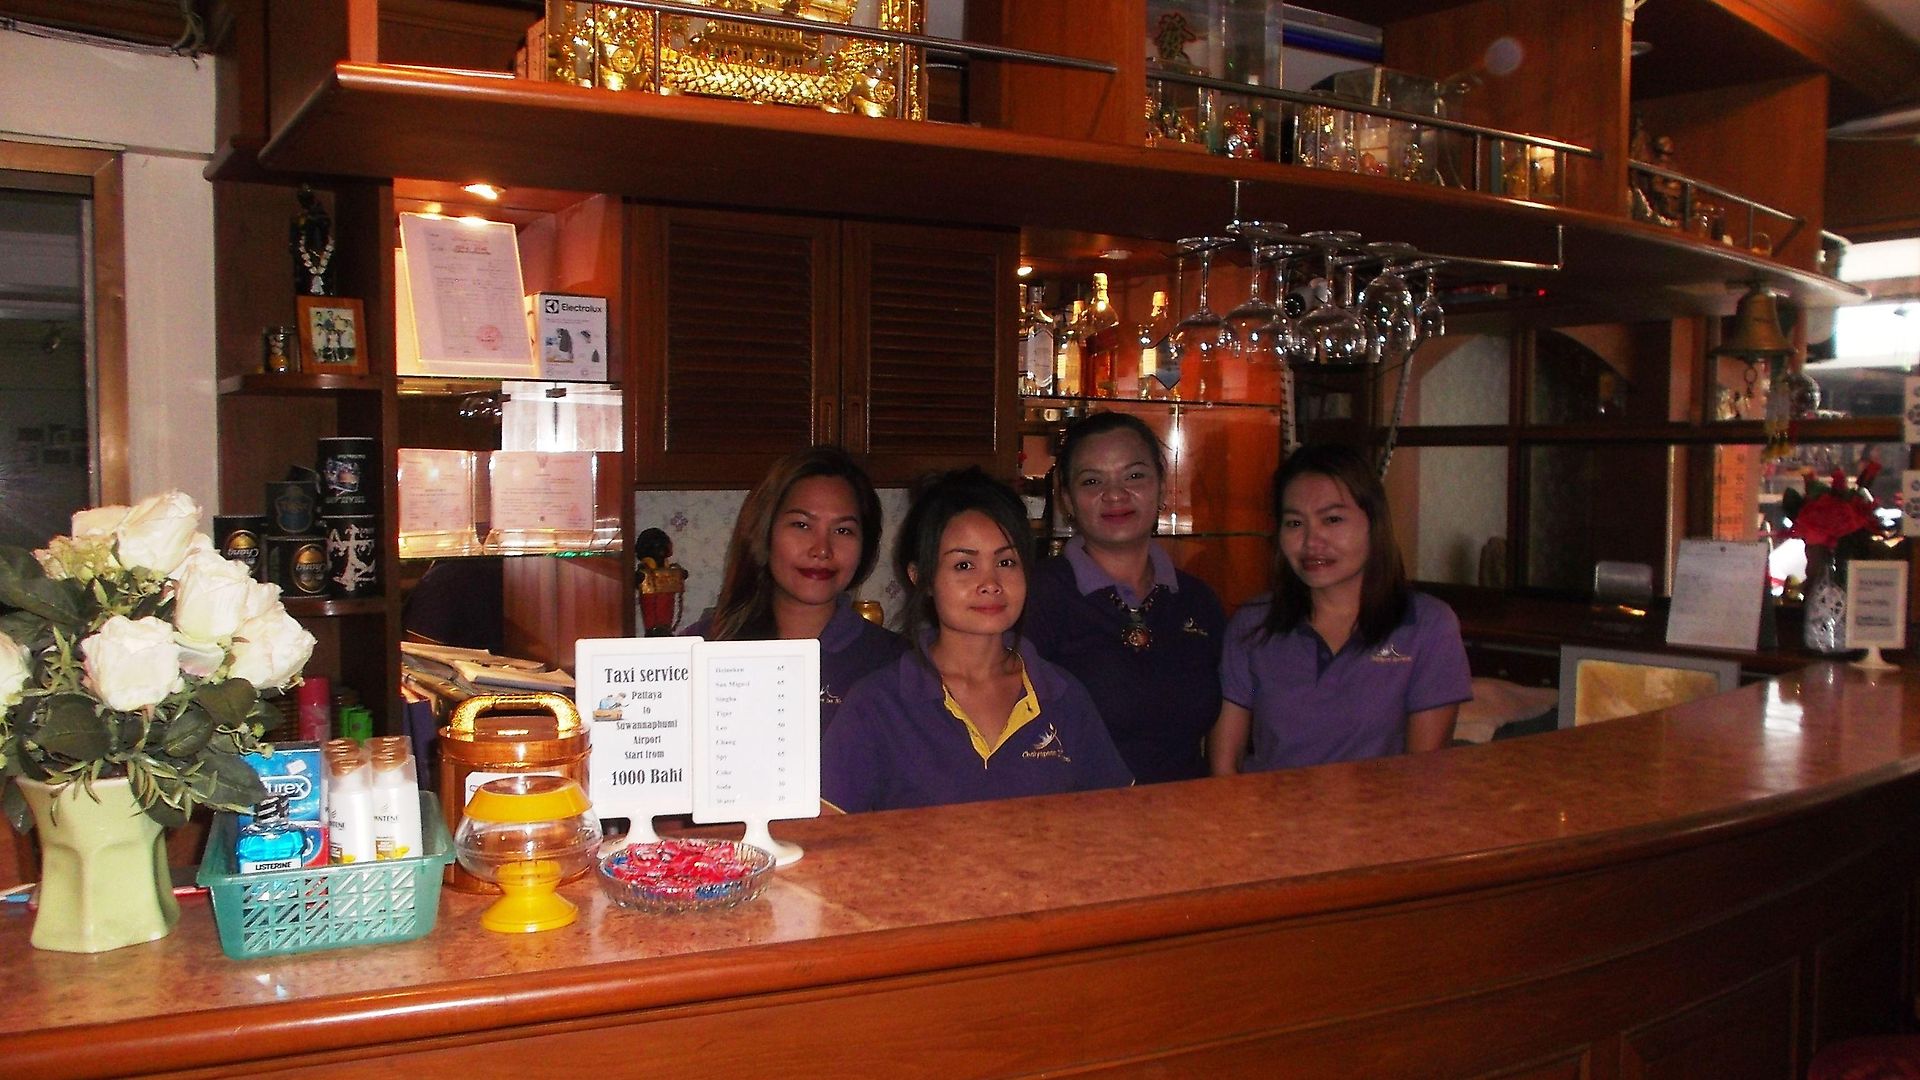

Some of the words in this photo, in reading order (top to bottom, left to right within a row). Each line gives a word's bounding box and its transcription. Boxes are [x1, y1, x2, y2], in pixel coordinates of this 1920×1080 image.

[561, 302, 603, 313] Electrolux
[604, 667, 635, 683] Taxi
[639, 665, 689, 682] service
[631, 690, 663, 700] Pattaya
[633, 735, 662, 746] Airport
[624, 751, 643, 760] Start
[645, 750, 665, 759] from
[611, 769, 645, 786] 1000
[651, 767, 683, 784] Baht
[265, 782, 305, 795] urex
[255, 861, 292, 871] LISTERINE
